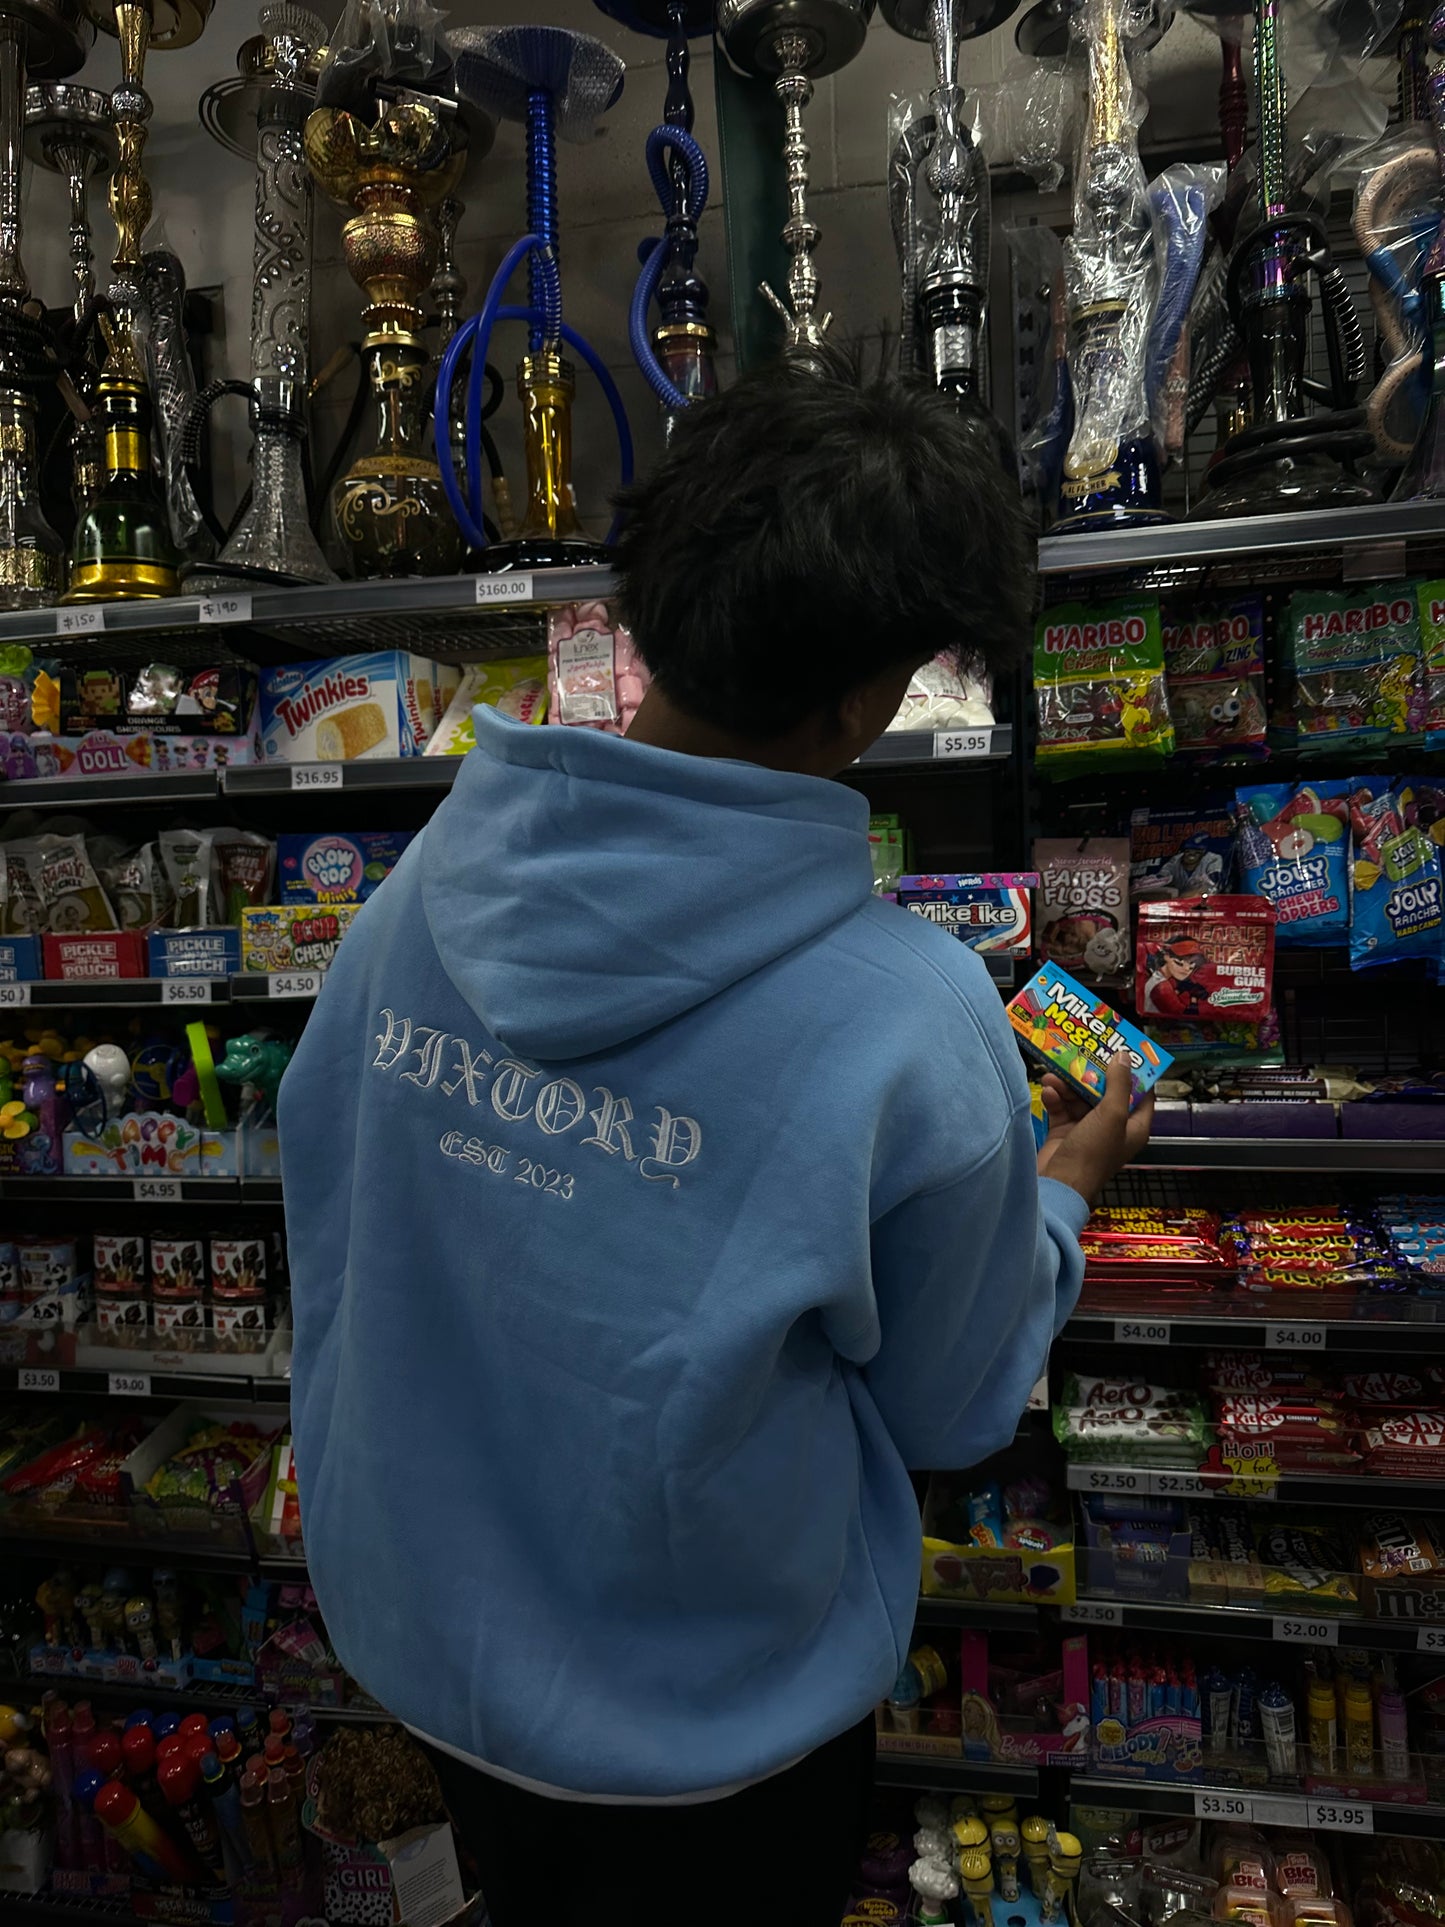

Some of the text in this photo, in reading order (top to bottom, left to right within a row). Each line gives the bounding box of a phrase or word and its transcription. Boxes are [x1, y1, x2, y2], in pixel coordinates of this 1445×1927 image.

[479, 582, 526, 597] $160.00
[203, 601, 238, 617] $190
[63, 613, 96, 630] $150
[1303, 599, 1413, 640] HARIBO
[1044, 616, 1146, 653] HARIBO
[1162, 614, 1250, 653] HARIBO
[275, 672, 369, 737] Twinkies
[406, 679, 429, 747] Twinkies
[945, 736, 986, 752] $5.95
[81, 749, 130, 771] DOLL
[296, 771, 339, 785] $16.95
[307, 848, 355, 876] BLOW
[319, 866, 352, 887] POP
[1042, 869, 1113, 888] FAIRY
[1261, 859, 1324, 890] JOLLY
[317, 887, 358, 905] Minis
[1044, 887, 1121, 907] FLOSS
[1269, 878, 1326, 899] RANCHER
[1278, 889, 1324, 909] CHEWY
[1388, 881, 1438, 917] JOLLY
[909, 903, 971, 924] Mike
[979, 904, 1017, 924] Ike
[1276, 896, 1339, 923] OPPERS
[1394, 904, 1441, 927] RANCHER
[169, 938, 223, 952] PICKLE
[1186, 923, 1267, 947] LEAGUE
[63, 943, 114, 958] PICKLE
[294, 938, 342, 964] CHEW
[64, 964, 117, 977] POUCH
[169, 960, 224, 974] POUCH
[1216, 964, 1266, 977] BUBBLE
[276, 978, 314, 993] $4.50
[1233, 976, 1266, 988] GUM
[169, 986, 205, 999] $6.50
[1044, 1002, 1099, 1052] Mega
[1046, 981, 1107, 1036] Mike
[1106, 1031, 1144, 1069] Ike
[372, 1007, 702, 1191] VIXTORY
[100, 1118, 195, 1150] HAPPY
[439, 1129, 576, 1200] EST 2023
[140, 1184, 175, 1197] $4.95
[1122, 1325, 1167, 1340] $4.00
[1276, 1330, 1322, 1345] $4.00
[23, 1373, 55, 1387] $3.50
[114, 1378, 145, 1391] $3.00
[1354, 1372, 1423, 1402] KitKat
[1086, 1383, 1152, 1407] Aero
[1078, 1407, 1144, 1432] Aero
[1226, 1412, 1285, 1434] KitKat
[1382, 1412, 1445, 1446] itKat
[1222, 1441, 1275, 1459] HOT!
[1252, 1463, 1272, 1473] for
[1089, 1472, 1136, 1488] $2.50
[1158, 1476, 1206, 1492] $2.50
[1376, 1588, 1445, 1619] m&
[1070, 1607, 1115, 1621] $2.50
[1283, 1622, 1328, 1638] $2.00
[1202, 1799, 1245, 1815] $3.50
[1316, 1807, 1365, 1825] $3.95
[1149, 1827, 1190, 1851] PEZ
[340, 1868, 390, 1888] GIRL
[1233, 1874, 1266, 1889] BIG
[1283, 1867, 1316, 1879] BIG
